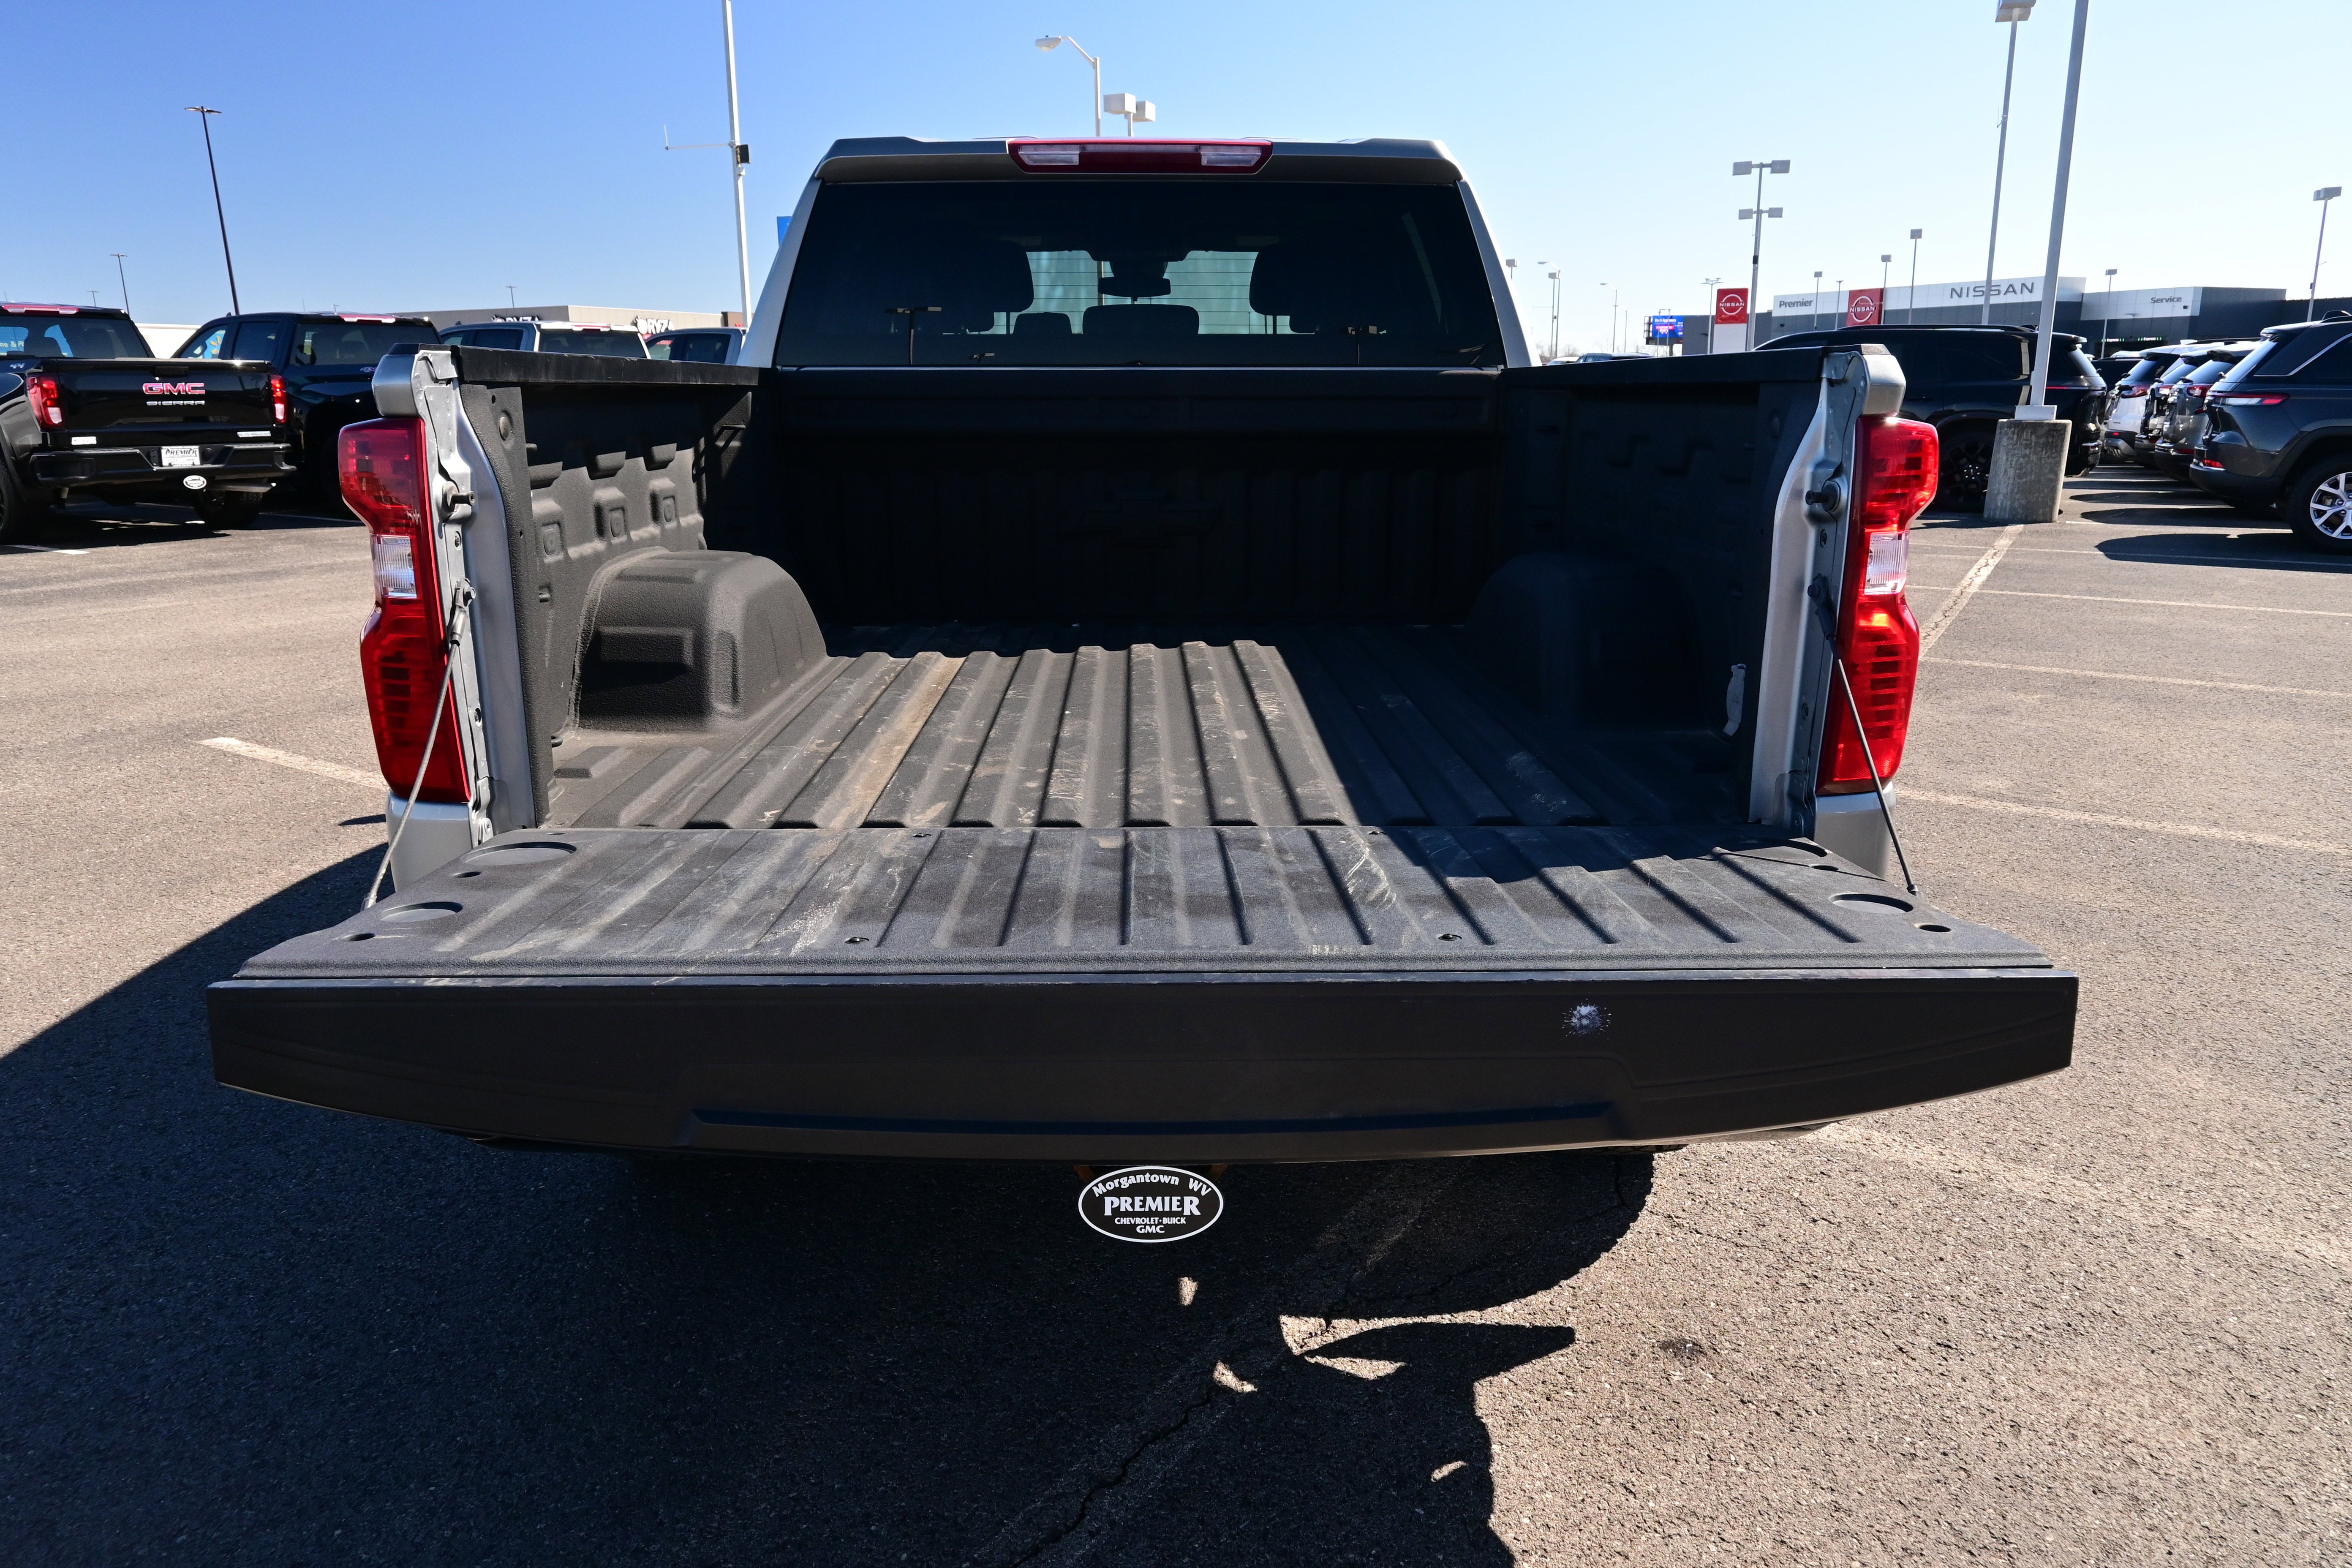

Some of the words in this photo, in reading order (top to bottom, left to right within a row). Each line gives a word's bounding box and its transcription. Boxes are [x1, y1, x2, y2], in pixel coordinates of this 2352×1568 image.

[1950, 282, 2034, 298] NISSAN
[1779, 298, 1813, 308] Premier
[143, 382, 205, 395] GMC
[1092, 1172, 1179, 1197] Morgantown
[1188, 1178, 1212, 1196] WV
[1104, 1196, 1201, 1216] PREMIER
[1136, 1225, 1165, 1233] GMC
